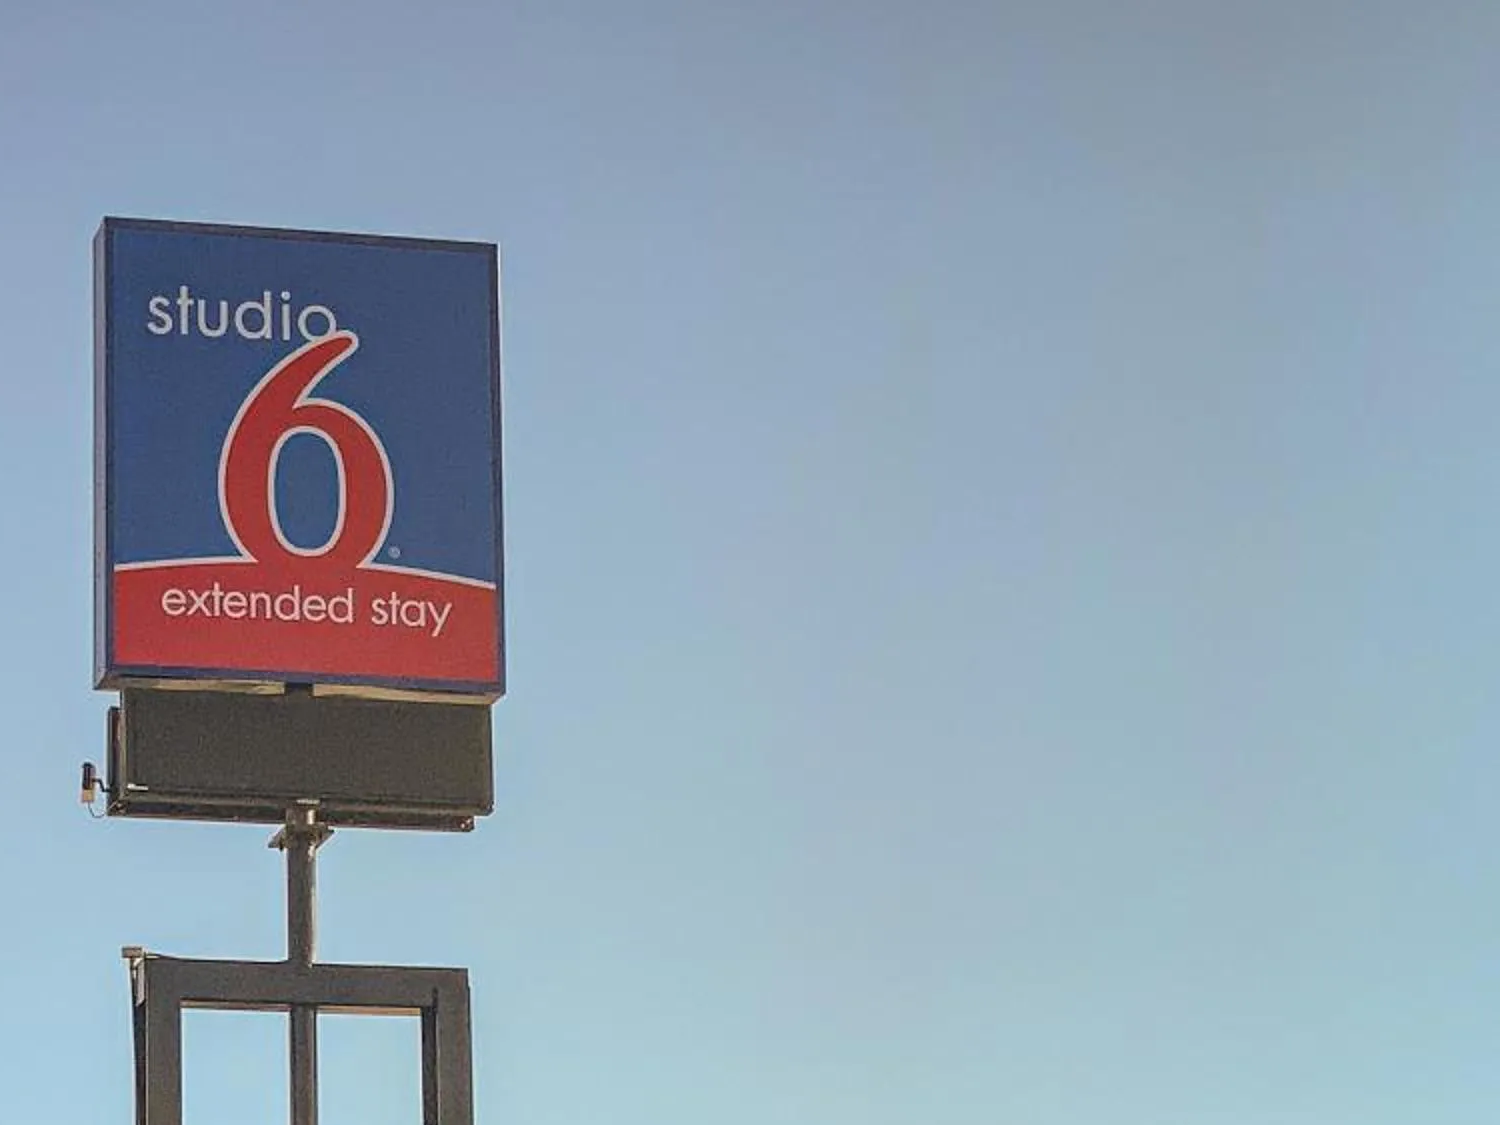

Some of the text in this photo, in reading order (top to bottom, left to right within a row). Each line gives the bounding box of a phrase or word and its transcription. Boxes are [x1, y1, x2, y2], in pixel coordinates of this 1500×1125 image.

[147, 284, 338, 345] studio
[218, 330, 395, 568] 6
[161, 582, 453, 637] extended stay
